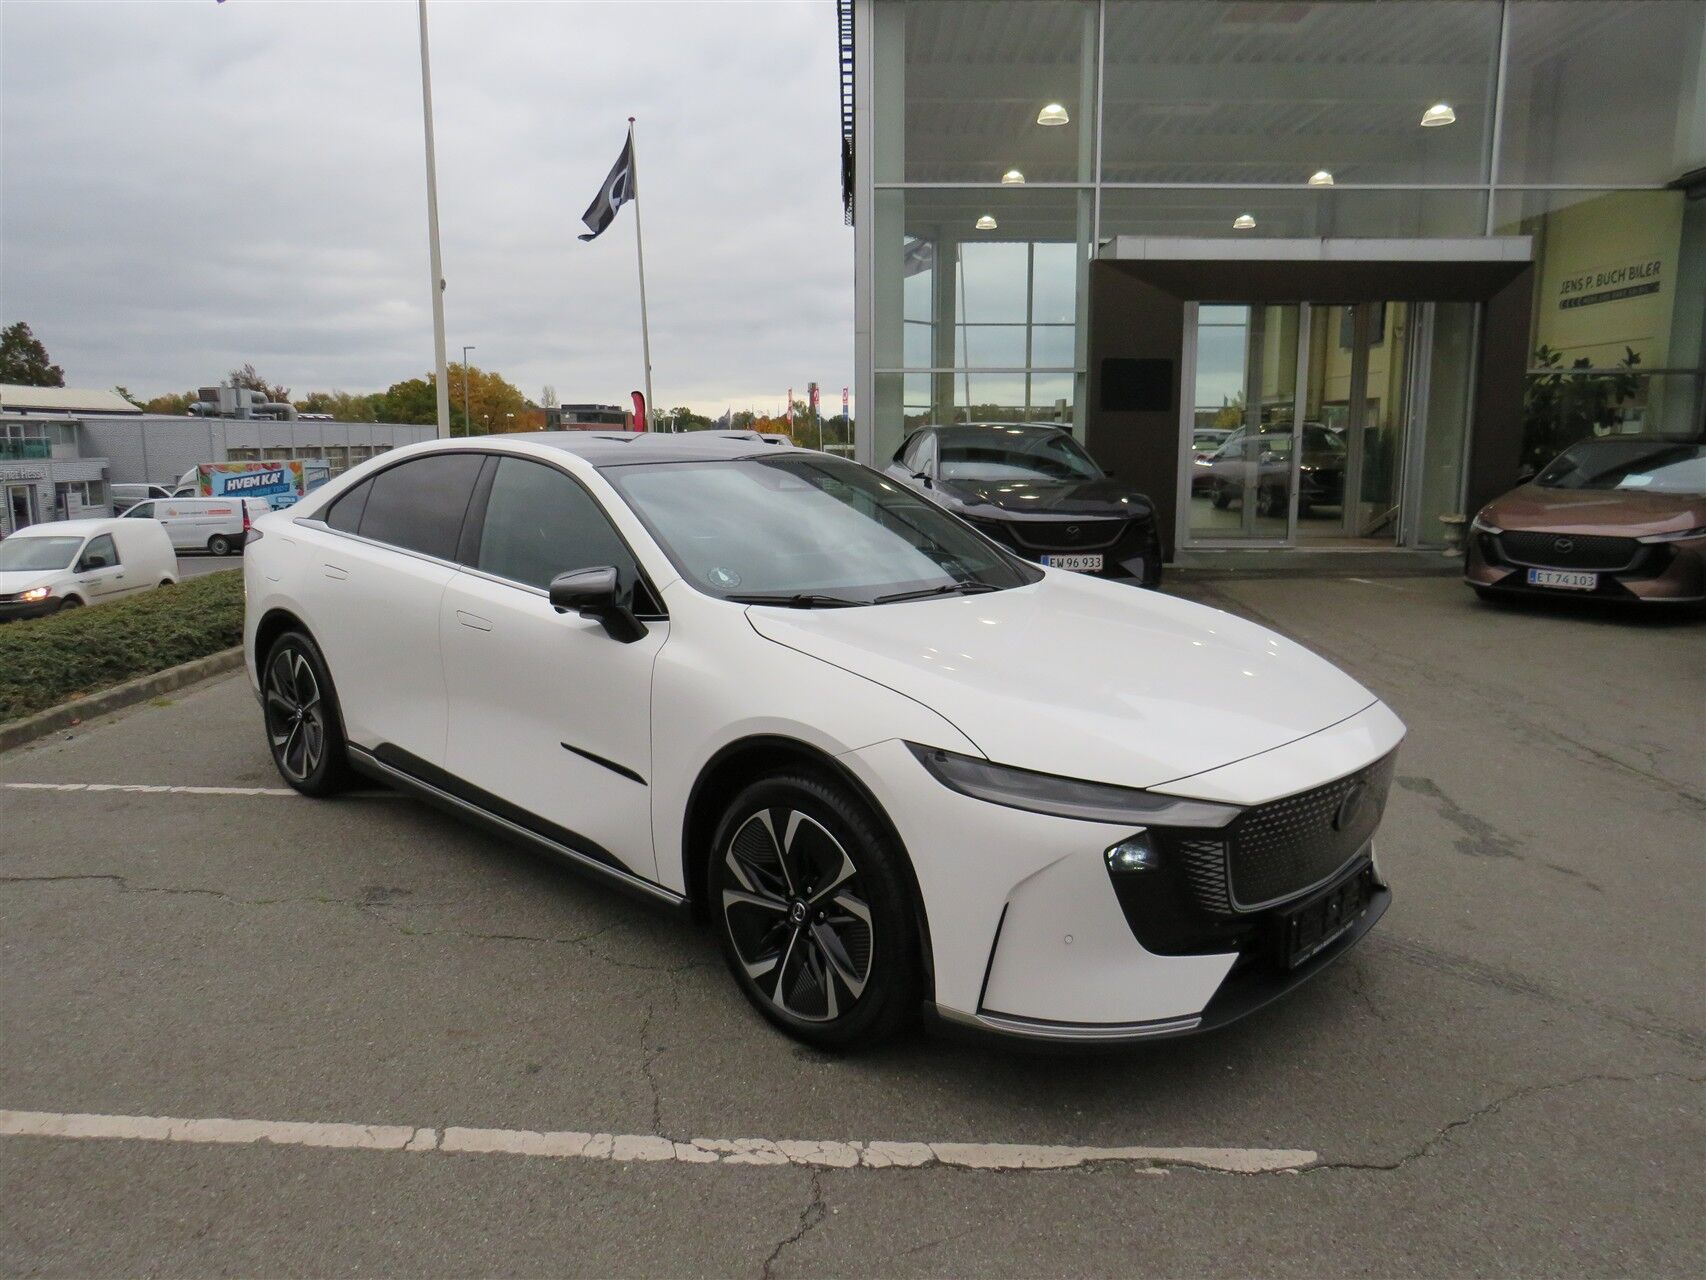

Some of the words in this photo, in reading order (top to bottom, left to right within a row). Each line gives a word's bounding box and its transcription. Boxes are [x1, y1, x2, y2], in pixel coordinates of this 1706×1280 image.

[1560, 278, 1583, 295] JENS
[1585, 275, 1594, 289] P.
[1596, 268, 1626, 288] BUCH
[1628, 261, 1661, 281] BILER
[226, 477, 261, 492] HVEM
[1050, 557, 1064, 568] EW
[1066, 557, 1079, 568] 96
[1082, 557, 1101, 568] 933
[1537, 572, 1551, 582] ET
[1555, 573, 1569, 584] 74
[1573, 575, 1594, 586] 103
